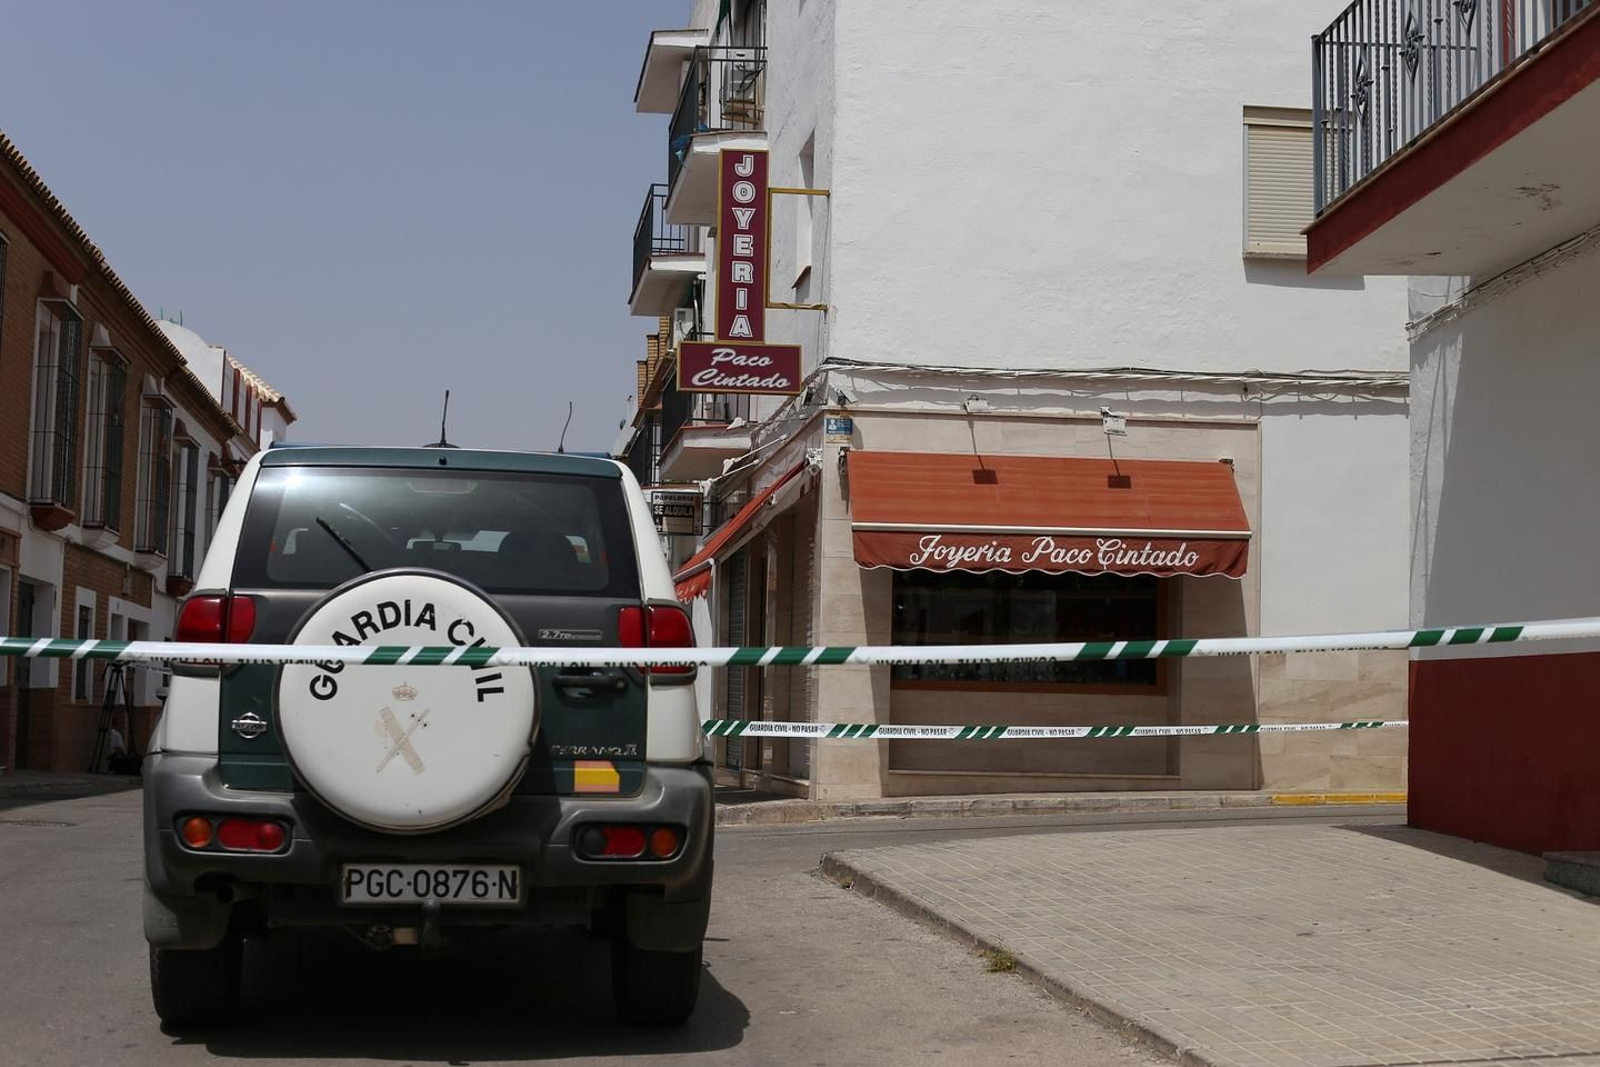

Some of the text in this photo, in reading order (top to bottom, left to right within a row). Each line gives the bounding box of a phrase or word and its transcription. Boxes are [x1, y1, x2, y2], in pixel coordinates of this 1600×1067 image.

[729, 155, 756, 338] JOYERIA
[711, 348, 773, 366] Paco
[692, 368, 791, 388] Cintado
[654, 505, 693, 516] SE ALQUILA
[910, 534, 1199, 570] Joyeria Paco Cintado
[750, 724, 773, 732] GUARDIA
[774, 724, 788, 732] CIVIL
[792, 725, 800, 733] NO
[801, 725, 818, 733] PASAR
[879, 727, 902, 735] GUARDIA
[903, 728, 916, 736] CIVIL
[921, 728, 929, 736] NO
[930, 728, 947, 736] PASAR
